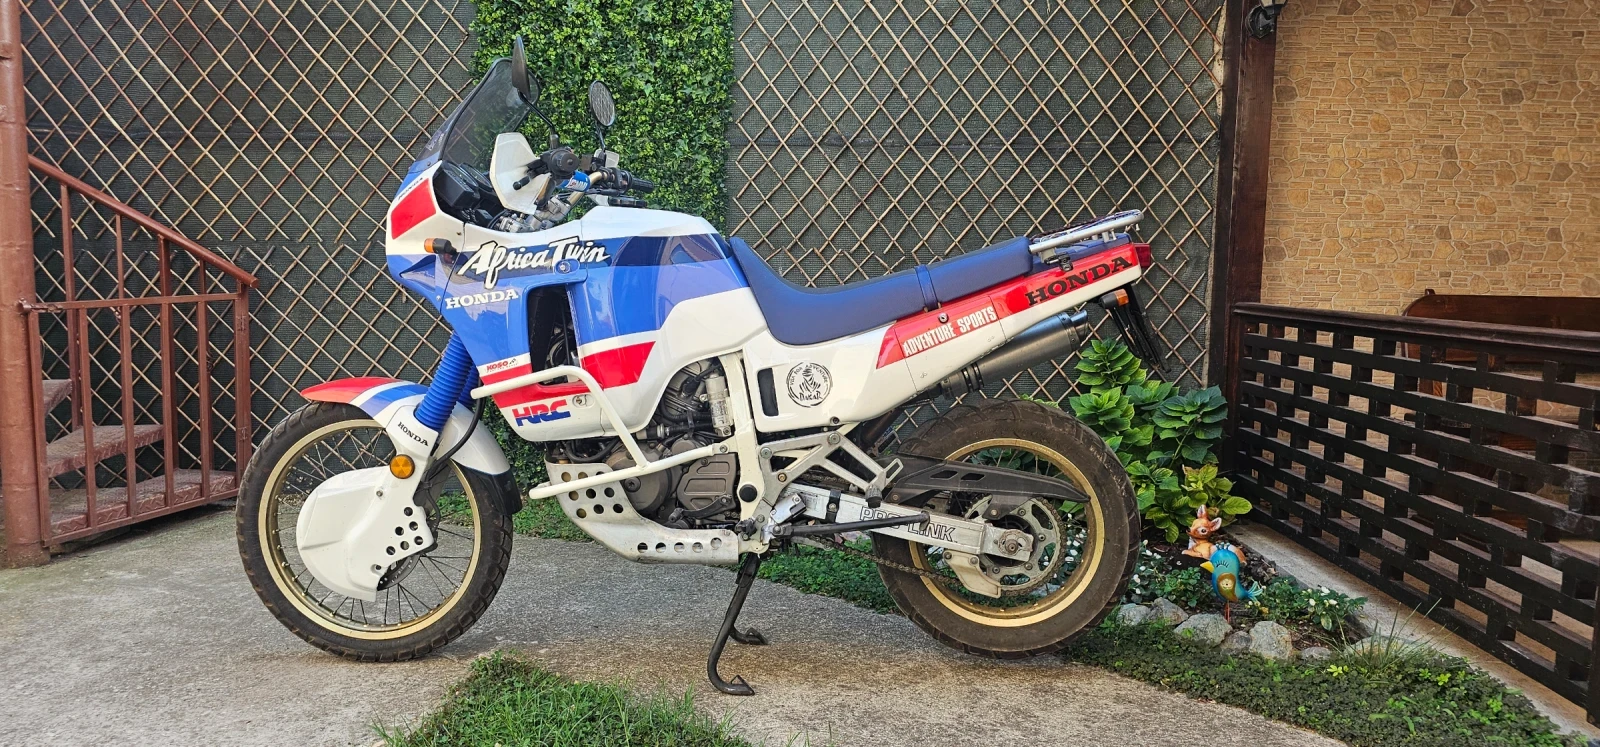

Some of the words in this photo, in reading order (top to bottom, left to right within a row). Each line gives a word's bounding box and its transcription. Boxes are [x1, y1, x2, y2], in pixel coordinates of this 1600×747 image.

[457, 240, 550, 290] Africa
[548, 235, 612, 268] Twin
[1025, 256, 1133, 306] HONDA
[445, 288, 520, 309] HONDA
[902, 322, 957, 357] ADVENTURE
[956, 306, 998, 333] SPORTS
[486, 360, 509, 372] KOSO
[511, 399, 572, 427] HRC
[397, 421, 429, 446] HONDA
[860, 506, 956, 543] PRLNK
